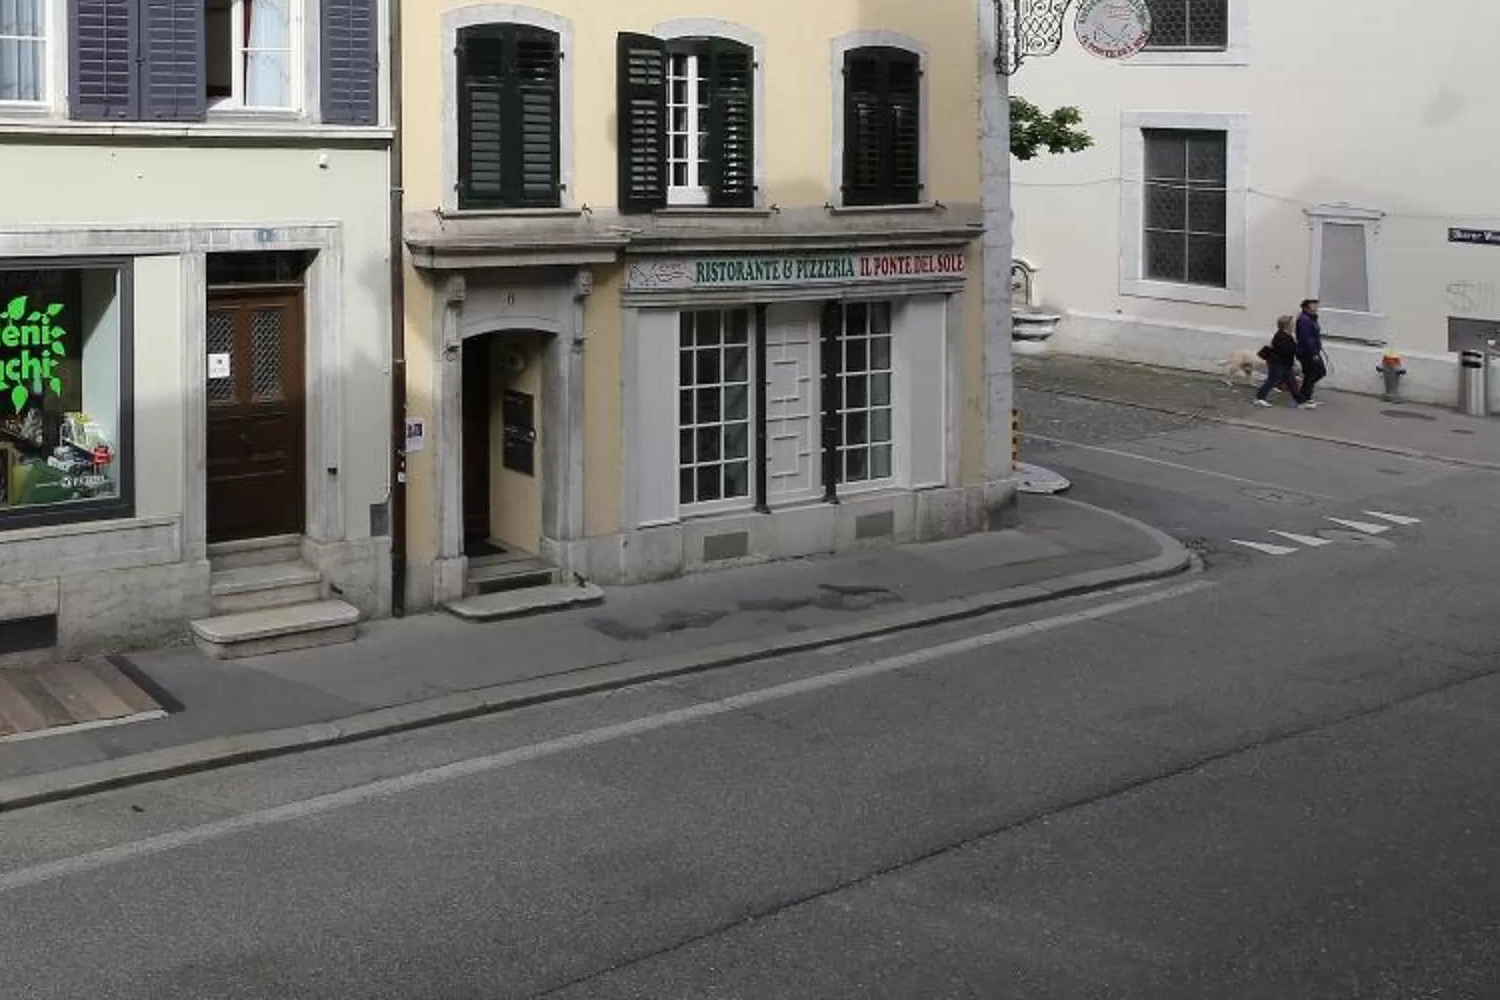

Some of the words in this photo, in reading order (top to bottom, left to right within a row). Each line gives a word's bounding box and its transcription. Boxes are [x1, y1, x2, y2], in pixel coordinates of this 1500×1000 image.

[695, 259, 781, 283] RISTORANTE
[783, 259, 793, 279] &
[796, 256, 855, 279] PIZZERIA
[859, 256, 872, 277] IL
[873, 255, 912, 276] PONTE
[914, 254, 935, 274] DEL
[937, 252, 965, 273] SOLE
